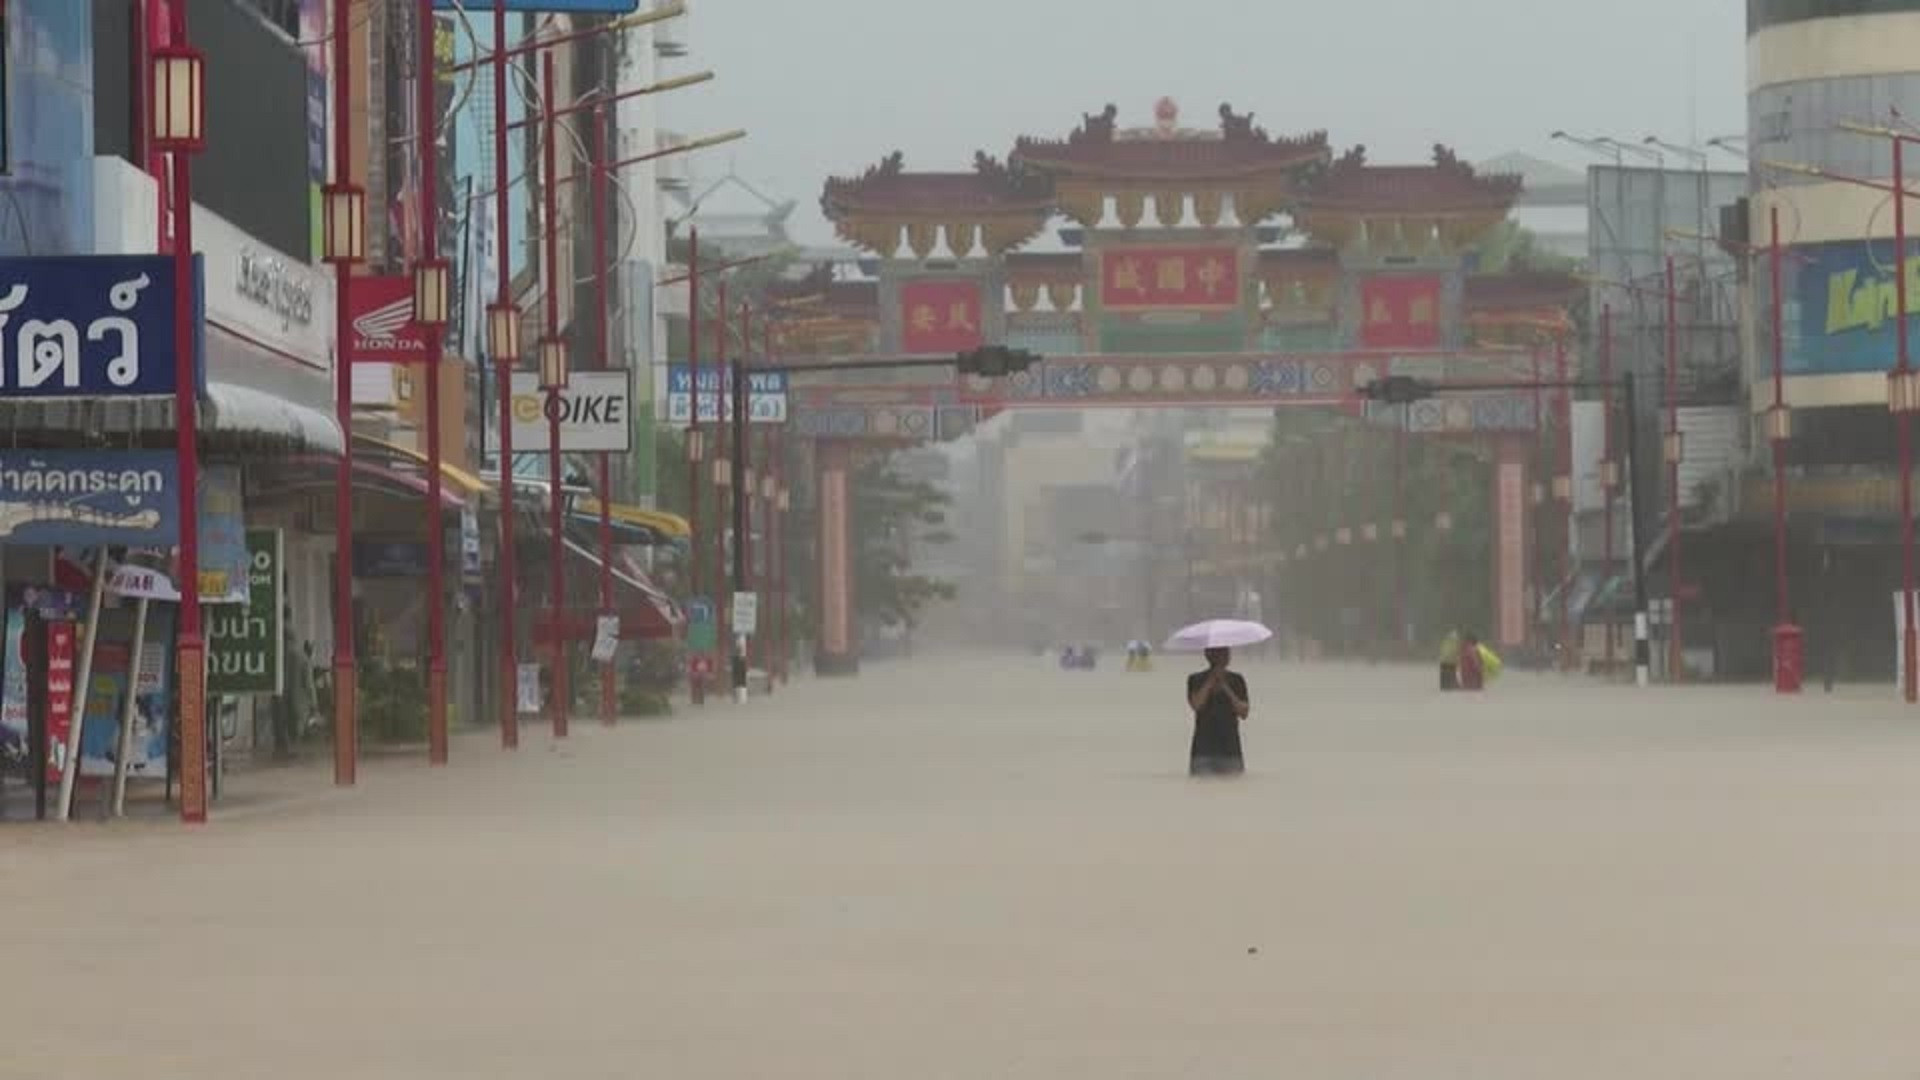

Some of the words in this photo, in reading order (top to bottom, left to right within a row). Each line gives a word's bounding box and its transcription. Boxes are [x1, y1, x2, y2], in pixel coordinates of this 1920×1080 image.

[0, 271, 150, 388] ัตว์
[353, 339, 426, 351] HONDA
[0, 459, 162, 506] าตัดกระดูก
